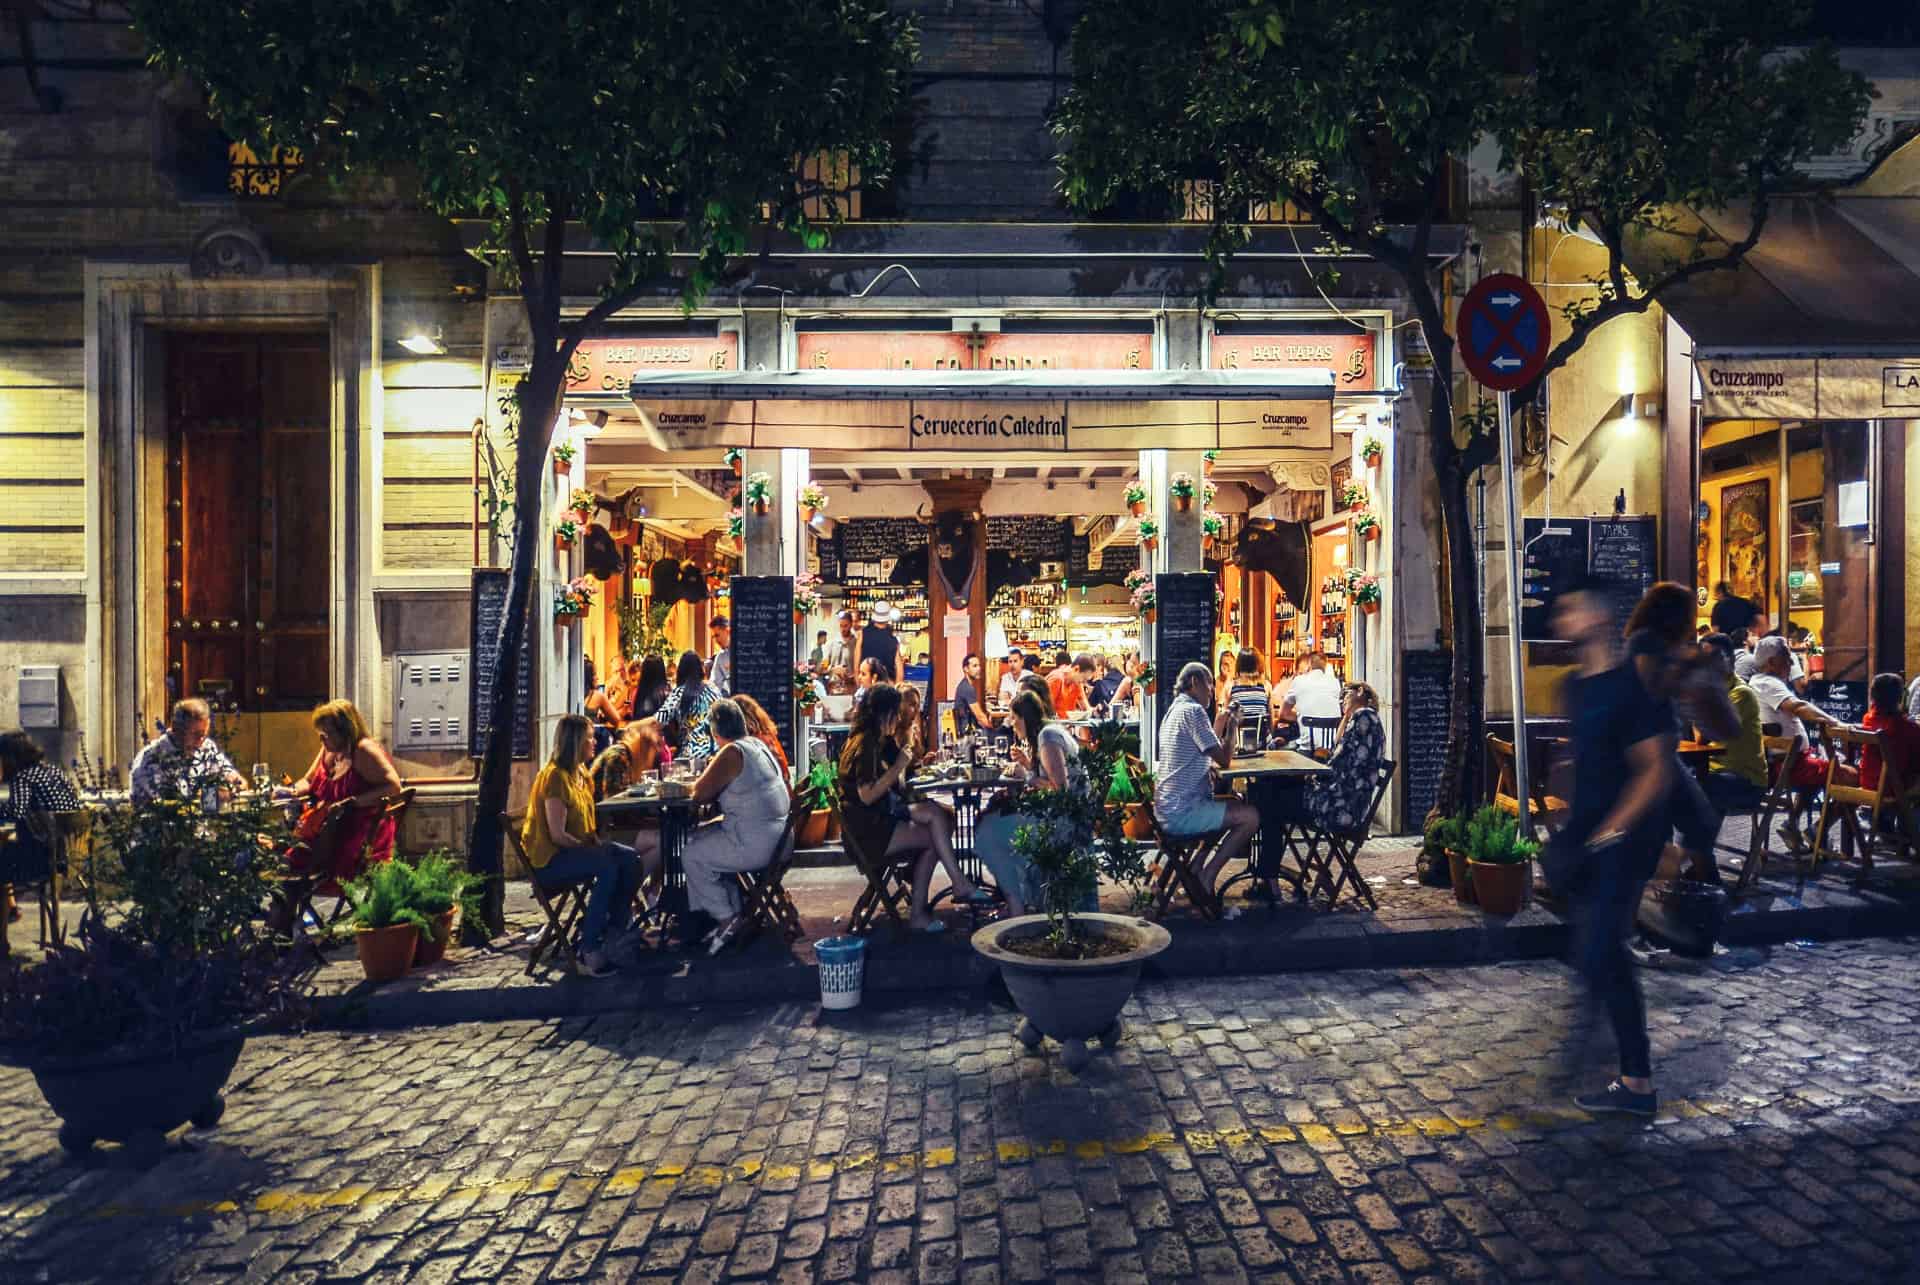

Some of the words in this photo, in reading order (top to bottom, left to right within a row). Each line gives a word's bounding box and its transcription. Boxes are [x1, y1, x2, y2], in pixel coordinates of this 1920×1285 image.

[606, 345, 638, 363] BAR
[640, 345, 691, 363] TAPAS
[1251, 344, 1282, 362] BAR
[1285, 344, 1333, 362] TAPAS
[1710, 368, 1784, 389] Cruzcampo
[1896, 375, 1919, 388] LA
[659, 412, 706, 425] Cruzcampo
[911, 414, 997, 437] Cervecería
[1000, 414, 1066, 437] Catedral
[1262, 413, 1308, 426] Cruzcampo
